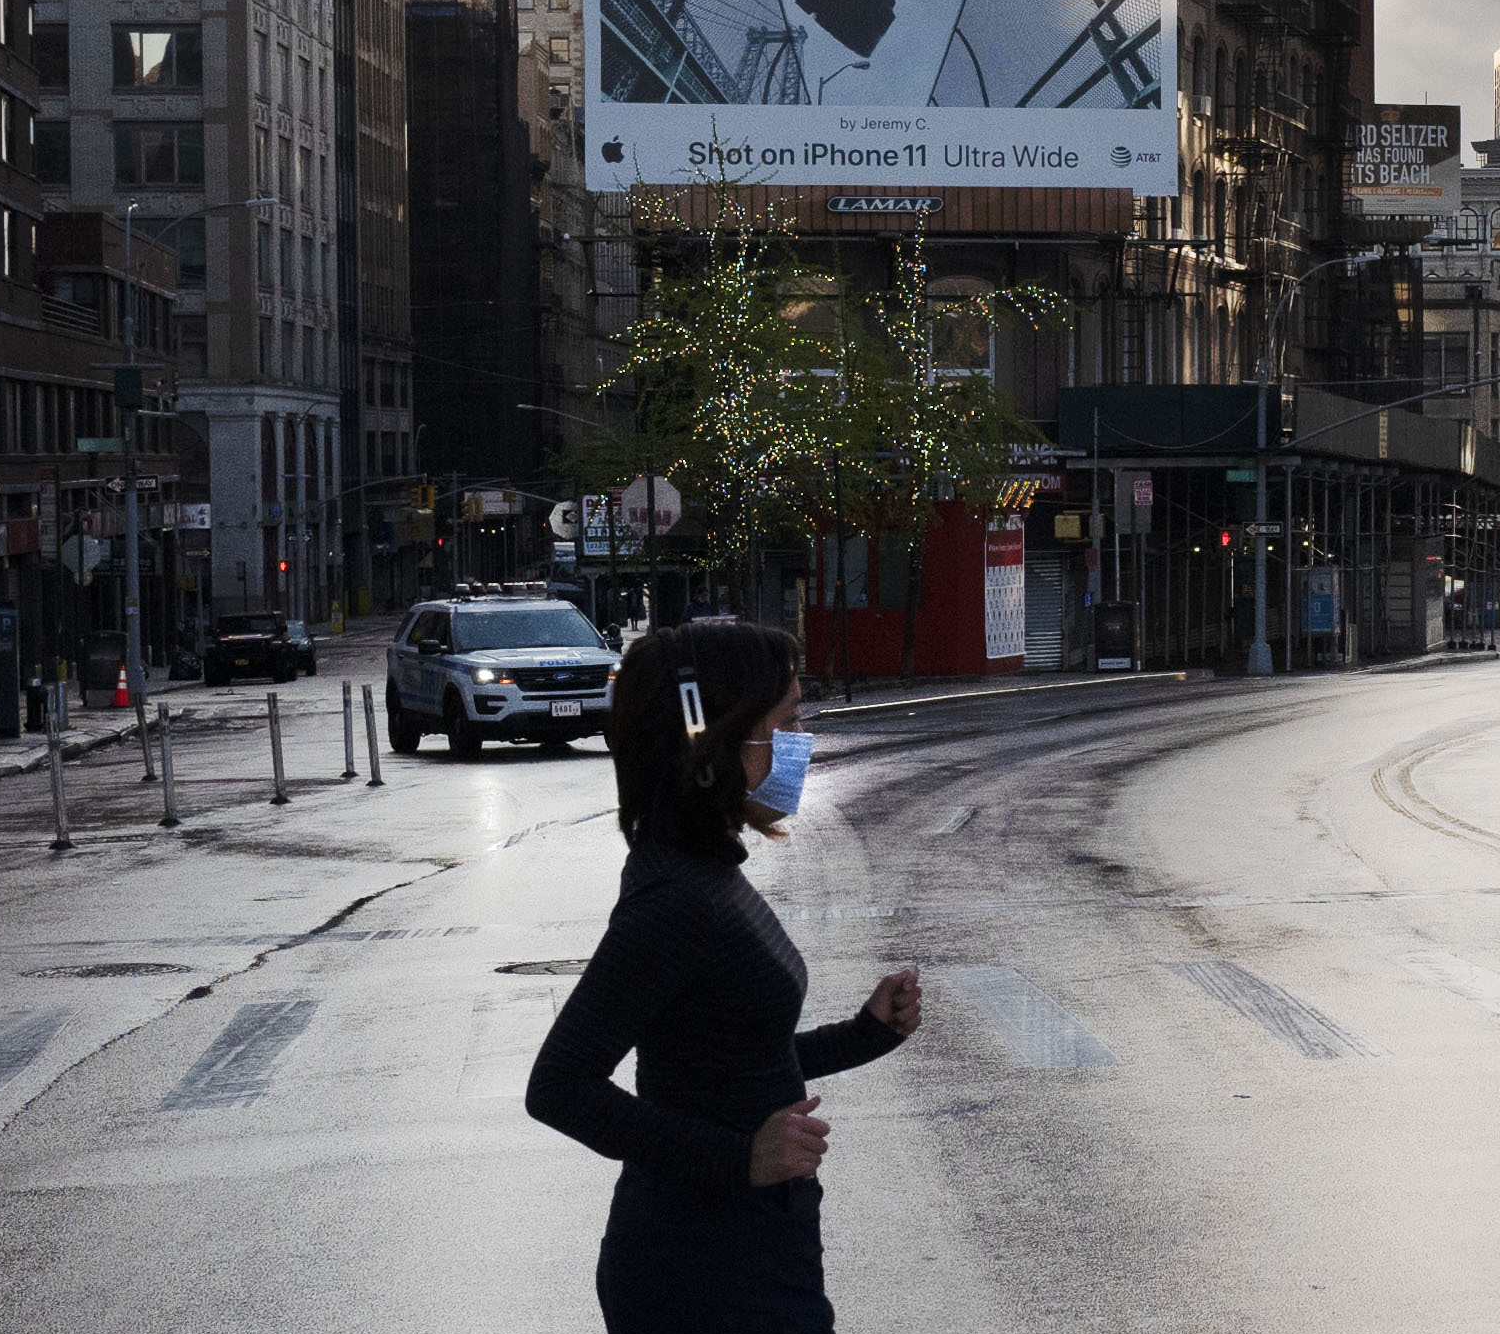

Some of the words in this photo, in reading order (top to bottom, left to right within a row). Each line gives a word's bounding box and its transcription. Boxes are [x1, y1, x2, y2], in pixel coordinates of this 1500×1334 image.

[840, 117, 857, 132] by
[861, 117, 911, 132] Jeremy
[915, 117, 931, 131] C.
[1381, 124, 1448, 148] SELTZER
[688, 141, 753, 166] Shot
[761, 147, 795, 166] on
[803, 142, 898, 167] iPhone
[903, 144, 928, 167] 11
[944, 144, 1006, 168] Ultra
[1013, 144, 1080, 169] Wide
[1136, 152, 1162, 163] AT&T
[1357, 147, 1381, 163] HAS
[1384, 147, 1424, 164] FOUND
[1380, 164, 1435, 184] BEACH.
[836, 198, 932, 211] LAMAR
[539, 659, 582, 667] POLICE
